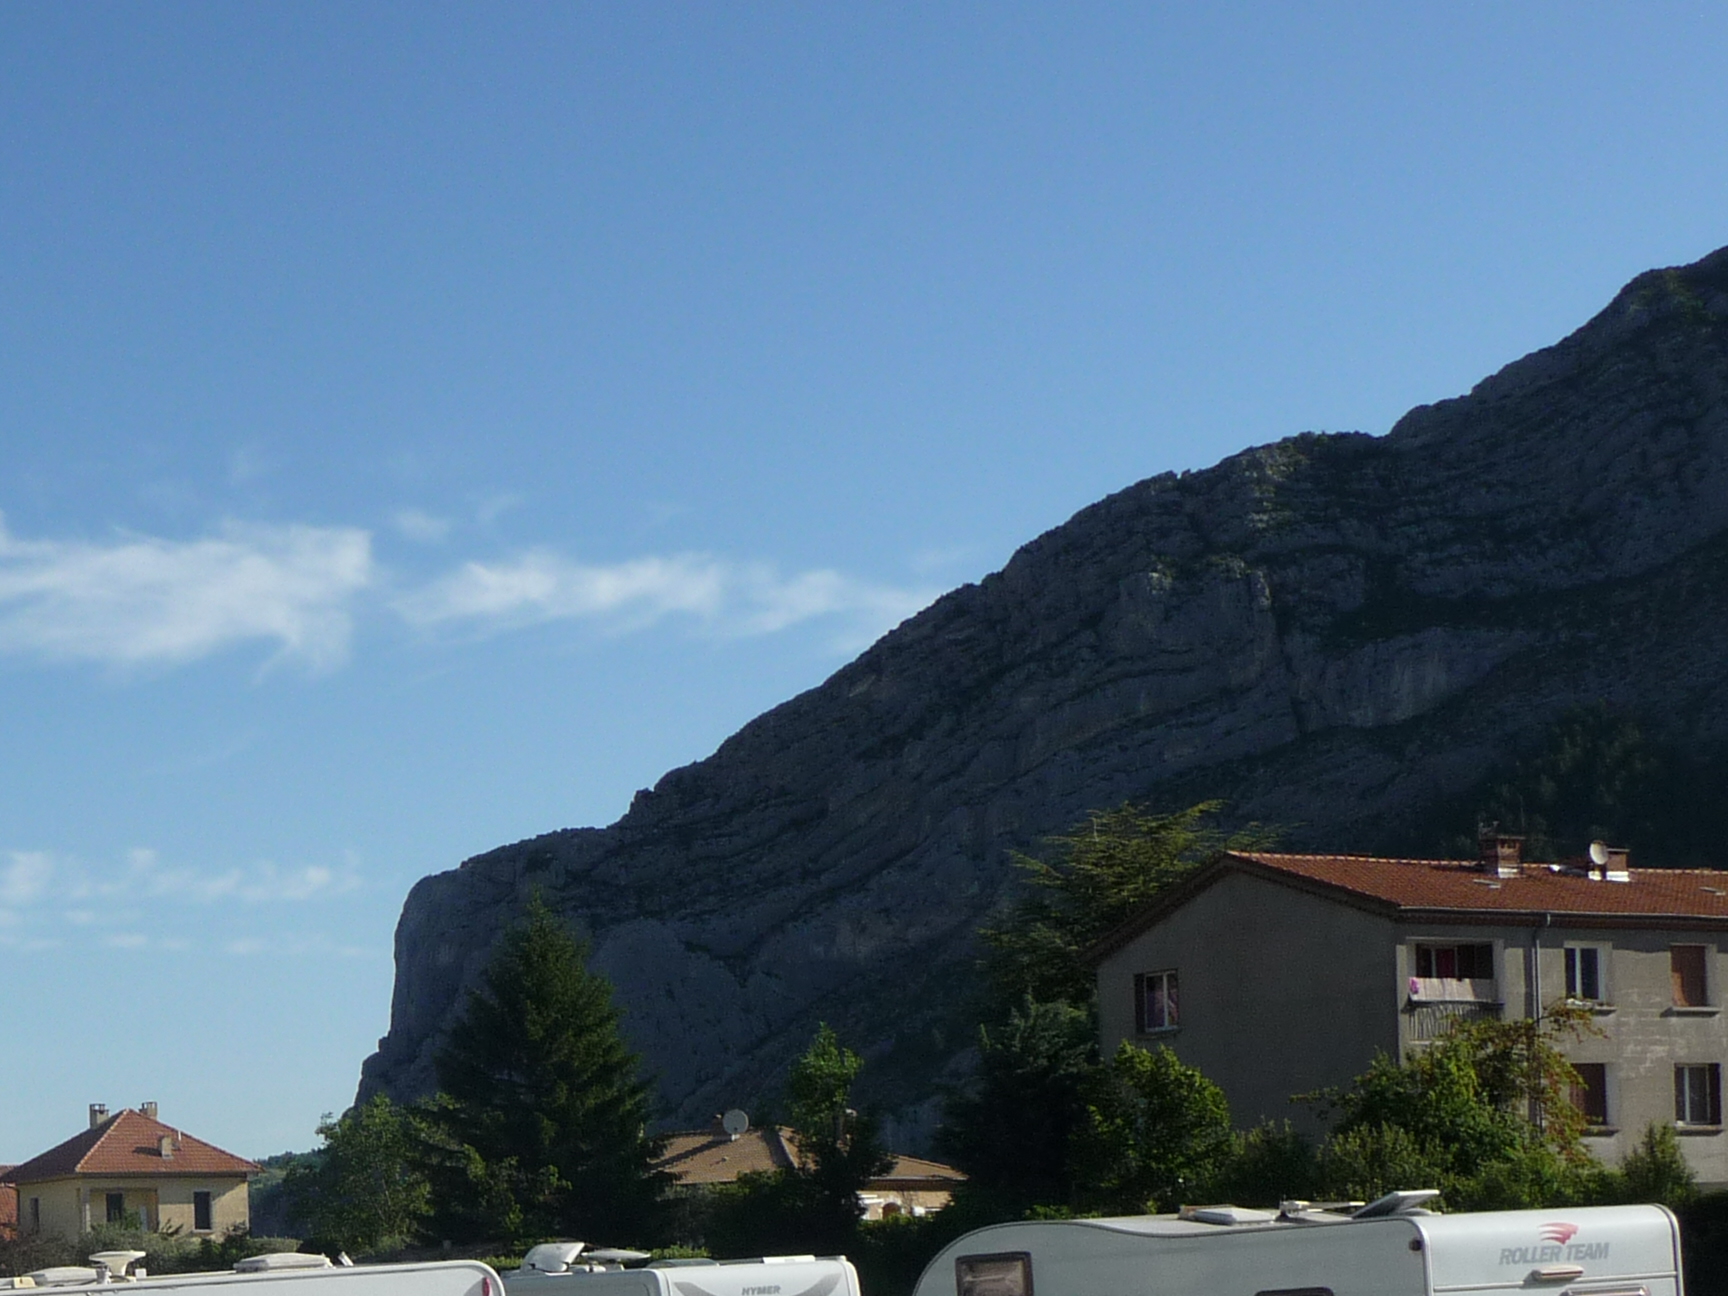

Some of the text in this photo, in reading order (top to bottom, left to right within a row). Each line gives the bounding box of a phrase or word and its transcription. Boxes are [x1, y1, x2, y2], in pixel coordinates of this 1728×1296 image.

[1499, 1242, 1610, 1265] ROLLER TEAM
[741, 1285, 781, 1296] HYMER
